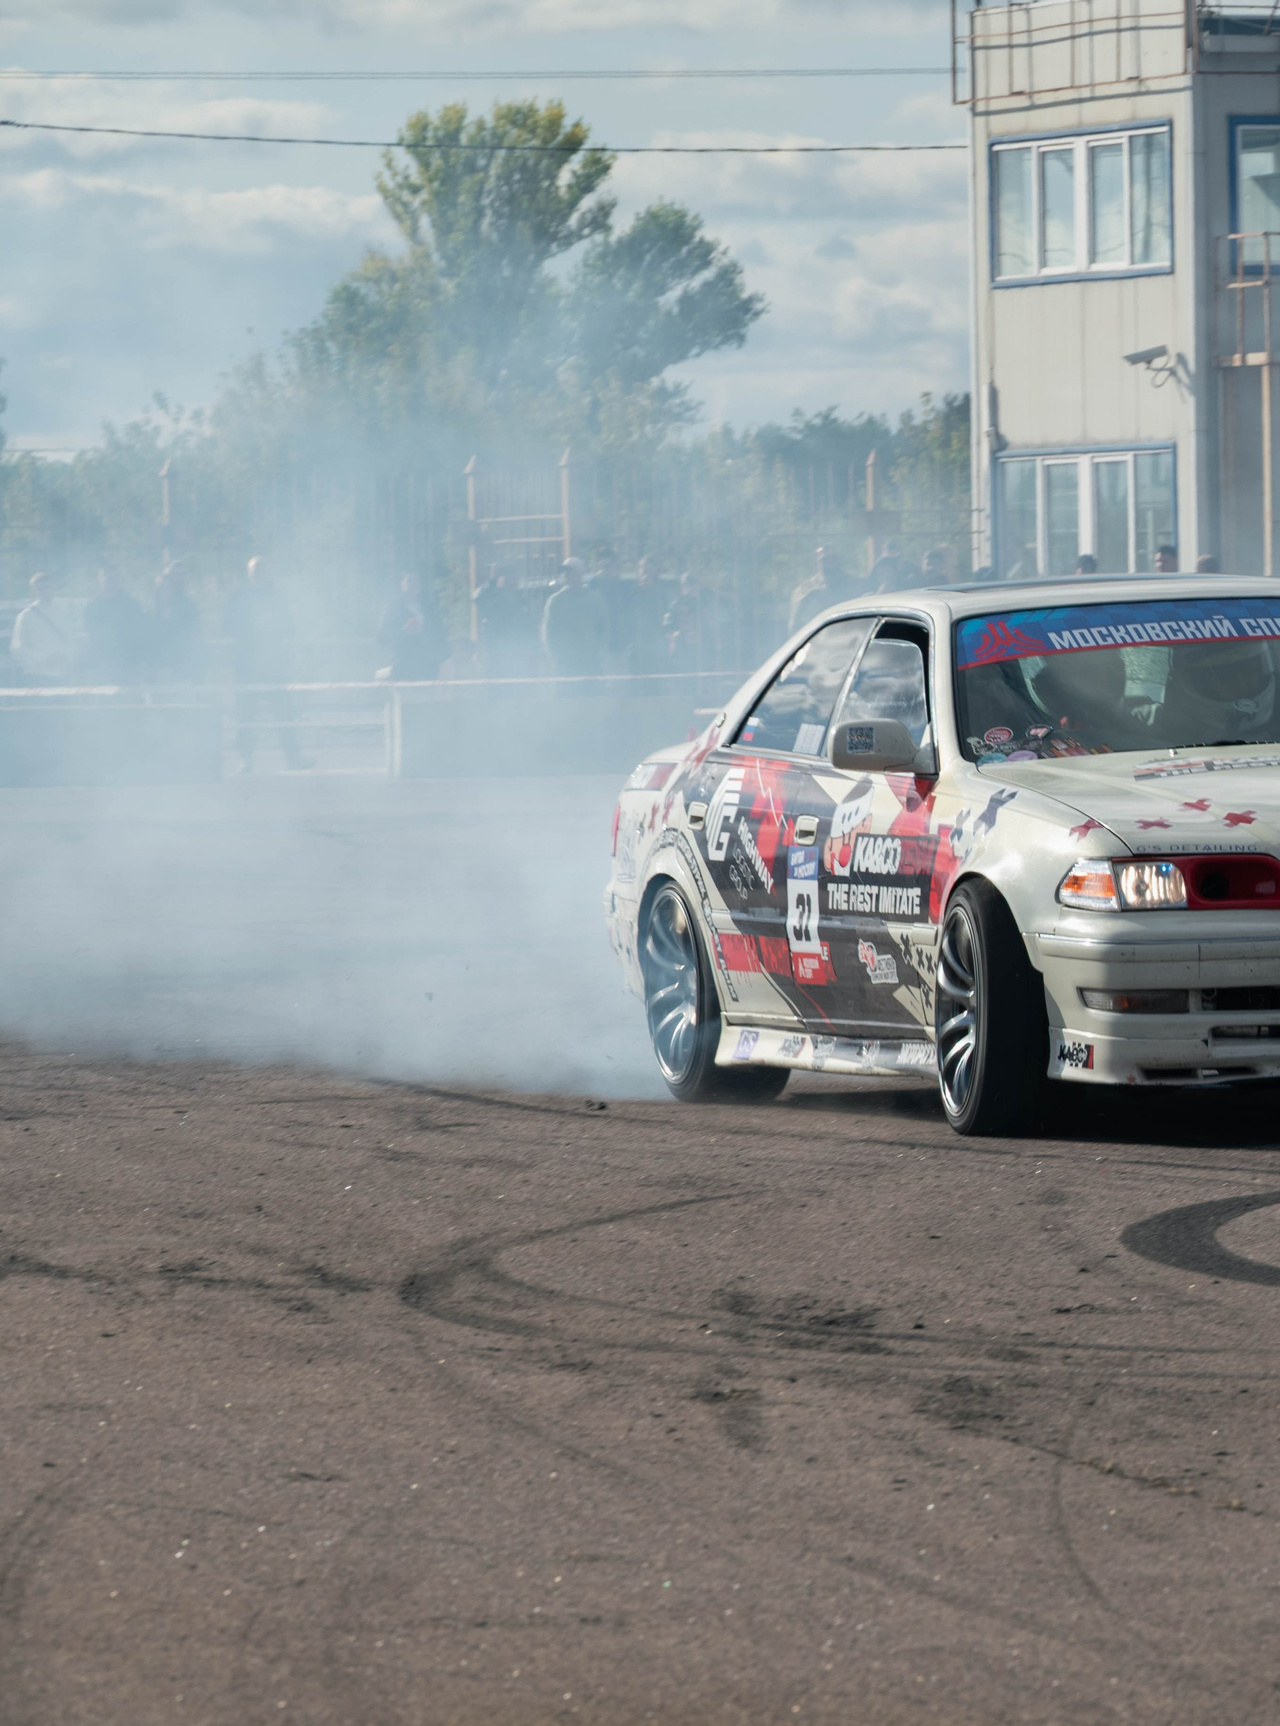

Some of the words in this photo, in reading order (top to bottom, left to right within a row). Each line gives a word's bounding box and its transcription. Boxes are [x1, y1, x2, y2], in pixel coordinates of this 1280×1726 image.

[1048, 615, 1239, 650] МОСКОВСКИЙ
[737, 816, 774, 895] HIGHWAY
[1169, 844, 1258, 852] DETAILING
[827, 883, 849, 912] THE
[879, 886, 921, 915] IMITATE
[793, 893, 812, 941] 31
